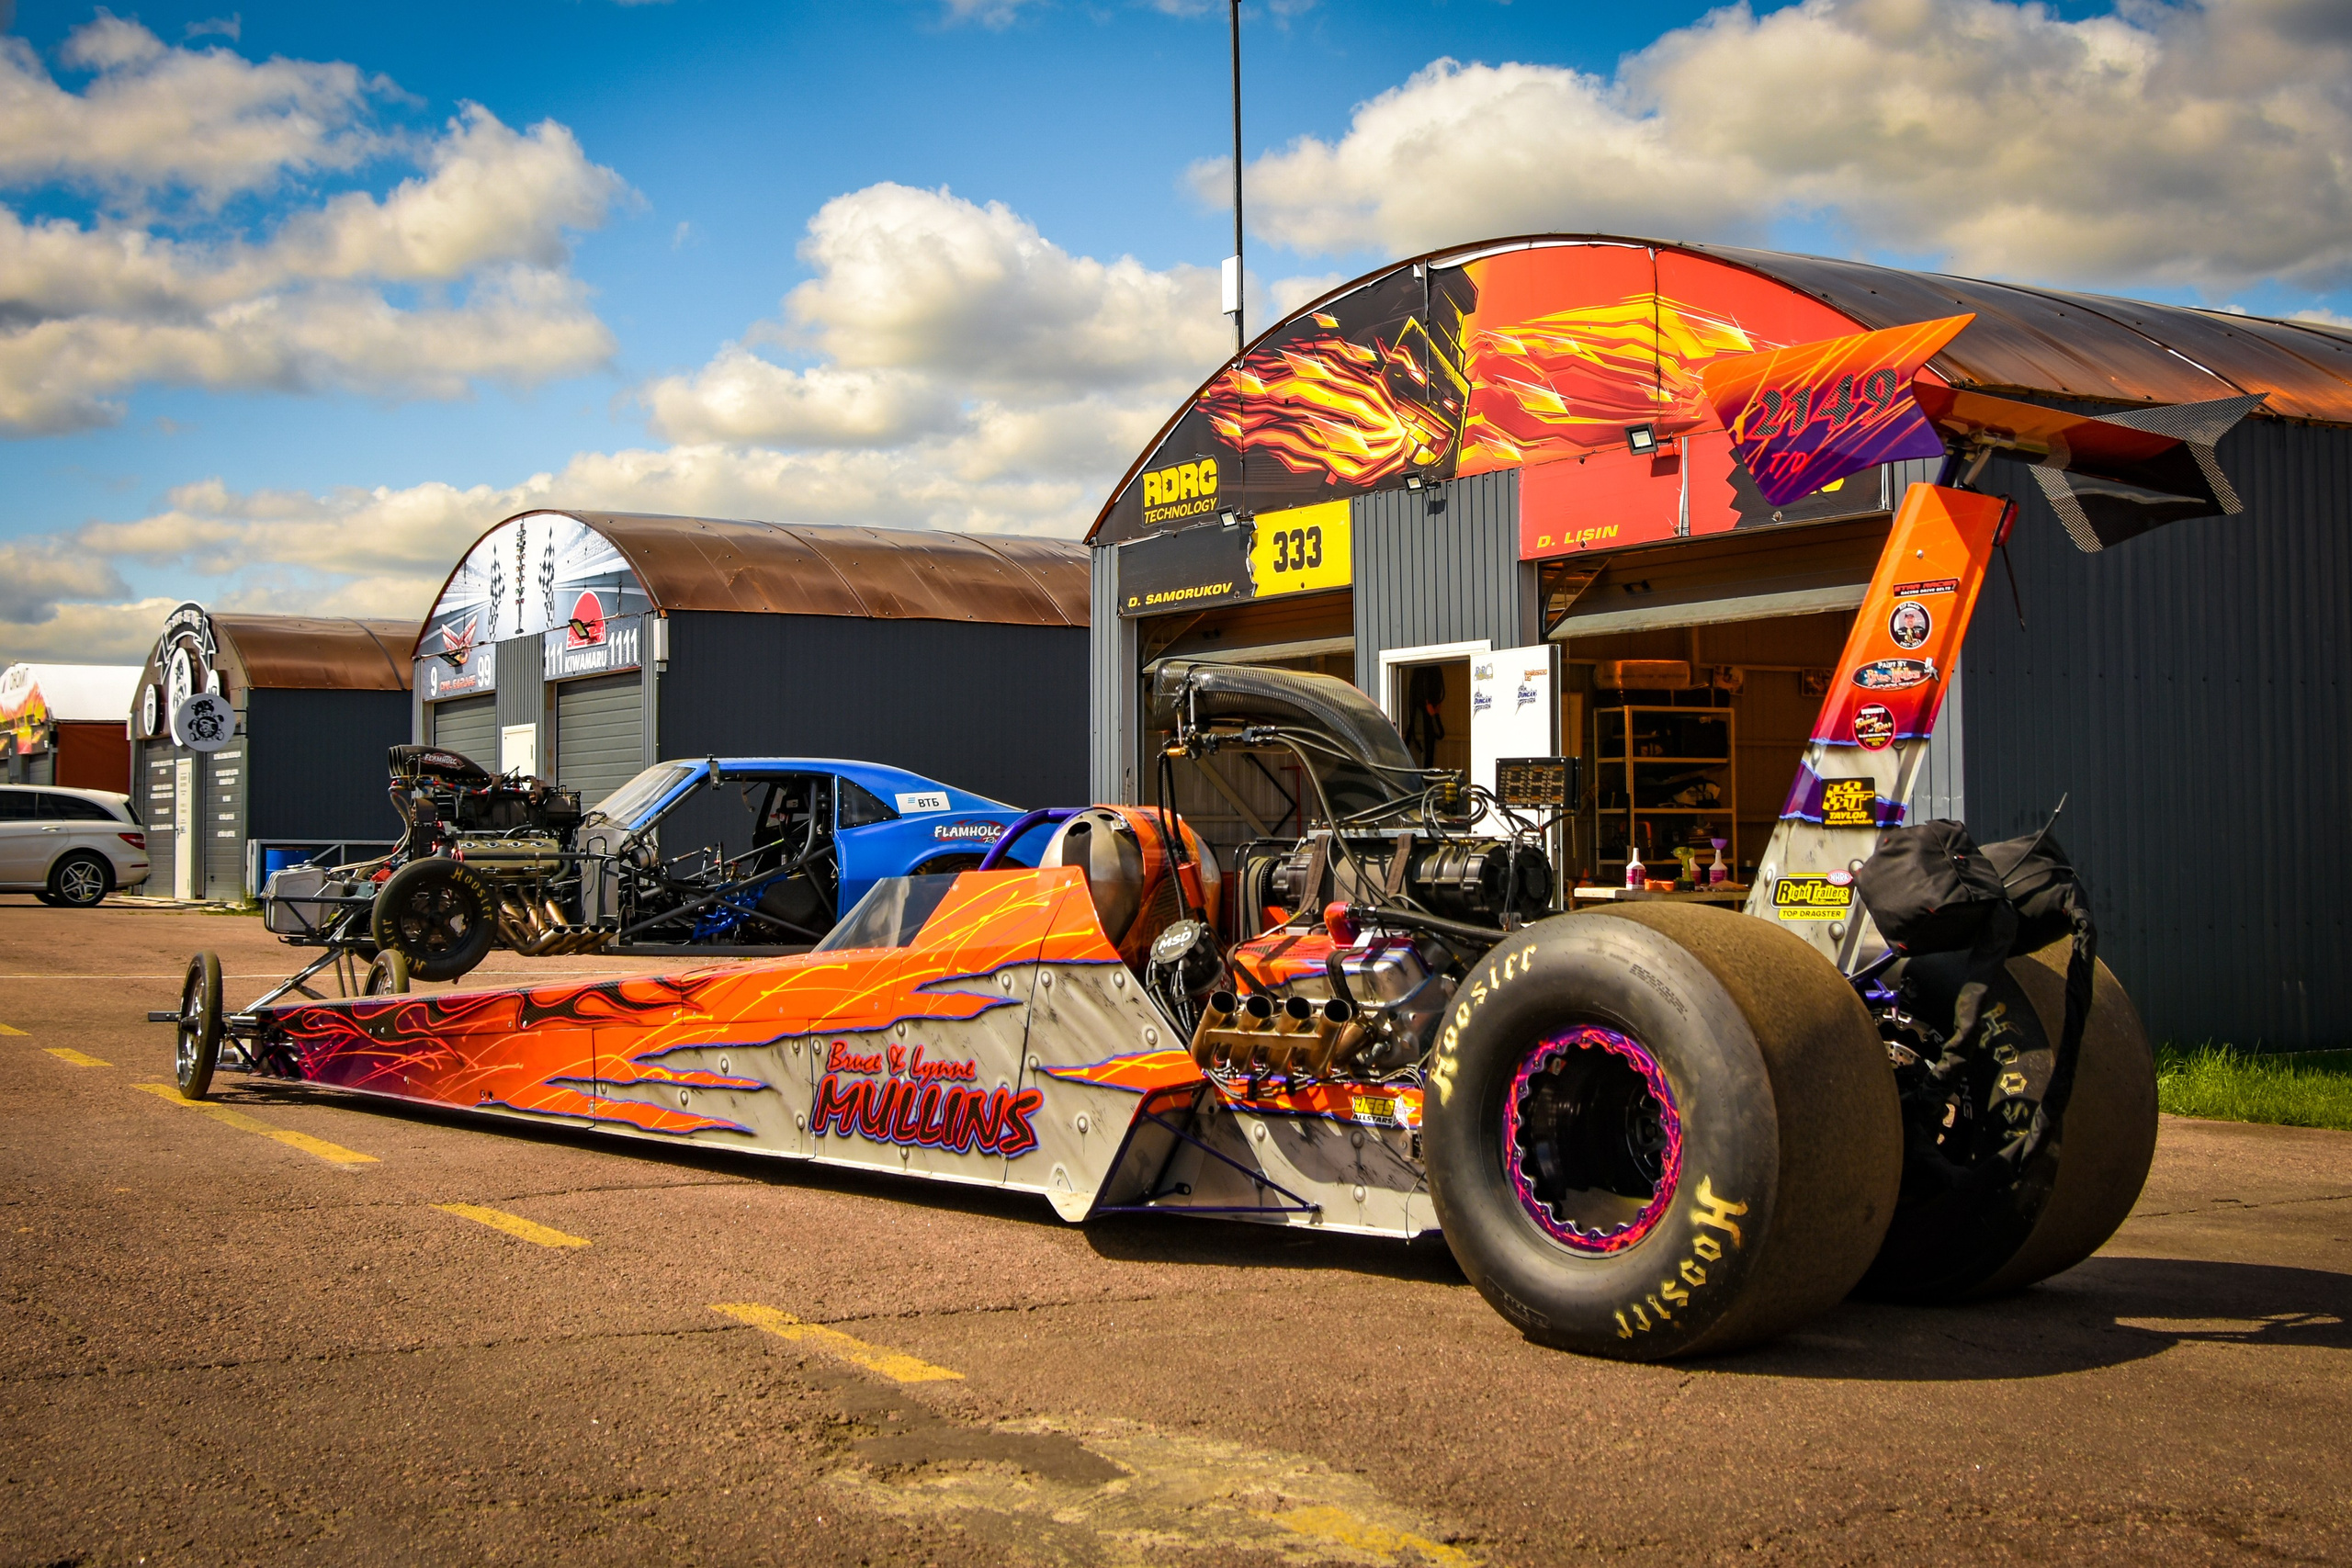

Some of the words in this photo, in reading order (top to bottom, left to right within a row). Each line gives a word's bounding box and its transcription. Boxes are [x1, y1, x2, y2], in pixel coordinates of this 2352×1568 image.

[1745, 365, 1899, 440] 2149
[1142, 458, 1217, 508] RDRC
[1144, 497, 1218, 525] TECHNOLOGY
[1273, 525, 1322, 573] 333
[1537, 536, 1555, 548] D.
[1564, 525, 1619, 544] LISIN
[1128, 597, 1141, 608] D.
[1145, 581, 1233, 605] SAMORUKOV
[545, 642, 563, 676] 111
[564, 650, 607, 672] KIWAMARU
[608, 628, 638, 665] 1111
[430, 666, 438, 696] 9
[478, 654, 492, 688] 99
[1829, 811, 1868, 819] TAYLOR
[1830, 873, 1850, 883] NHRA
[1158, 931, 1193, 951] MSD
[827, 1040, 883, 1073] Bruce
[888, 1044, 907, 1075] &
[910, 1044, 977, 1088] Lynne
[809, 1074, 1044, 1157] MULLINS
[1352, 1114, 1393, 1124] ALLSTARS
[1354, 1097, 1396, 1117] JEGS
